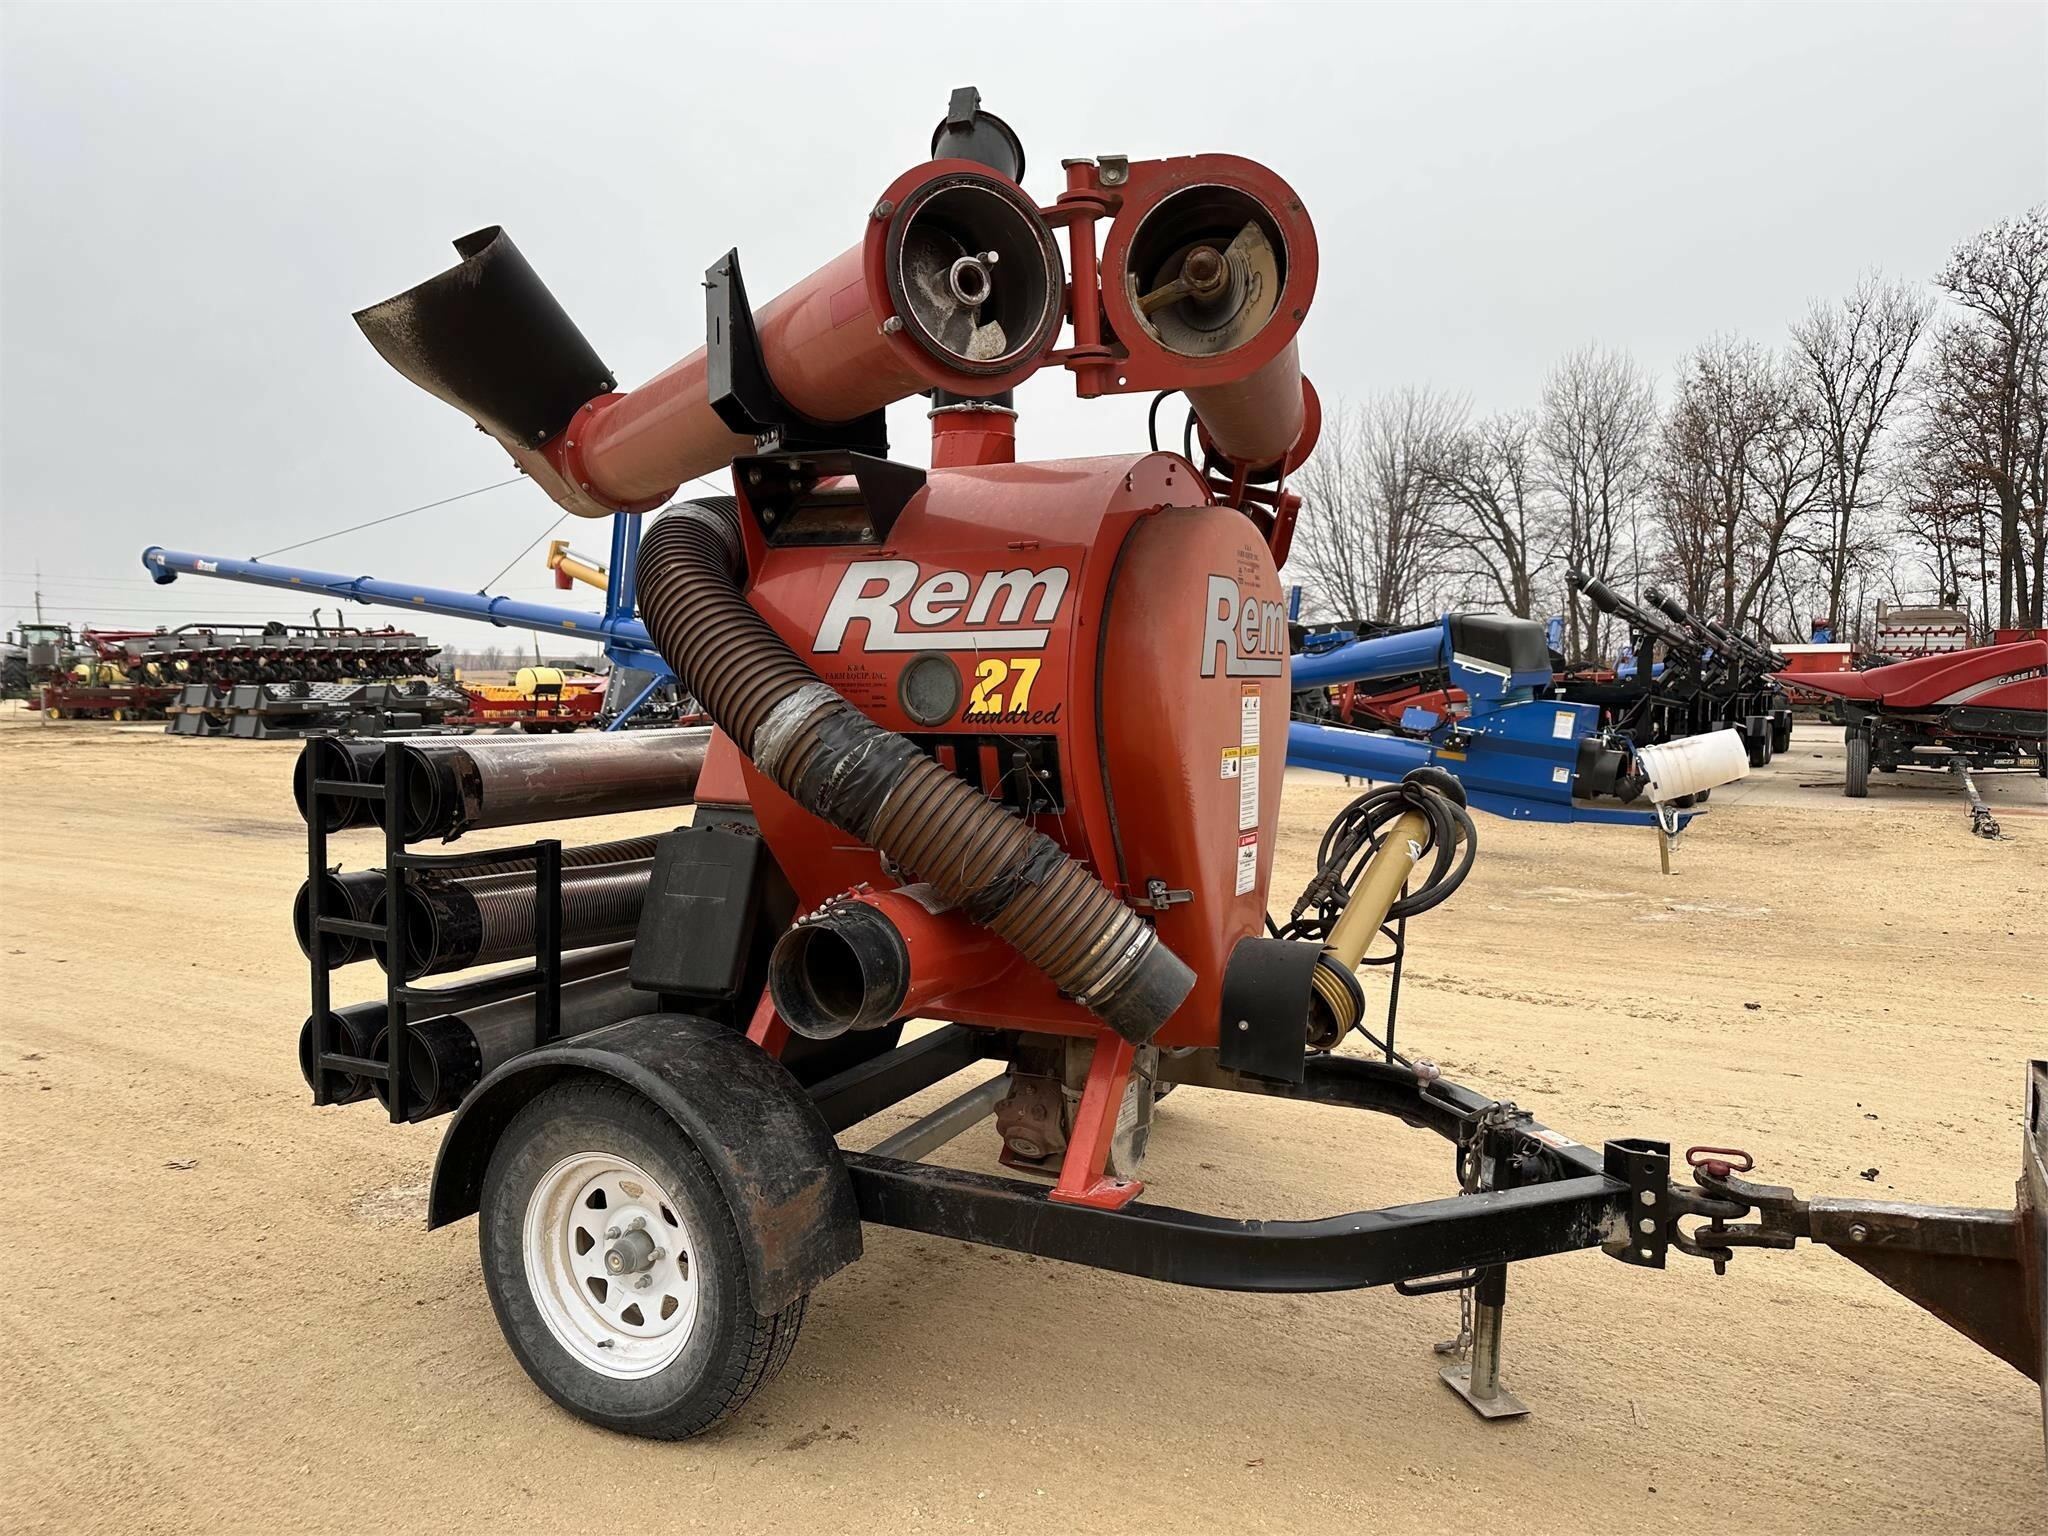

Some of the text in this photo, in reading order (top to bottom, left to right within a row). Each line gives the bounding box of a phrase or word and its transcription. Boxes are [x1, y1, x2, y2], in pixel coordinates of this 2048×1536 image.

[812, 559, 1069, 651] Rem
[1200, 574, 1284, 678] Rem
[825, 672, 845, 680] FARM
[970, 658, 1042, 714] 27
[1998, 672, 2028, 685] CASE
[961, 702, 1061, 724] hundred
